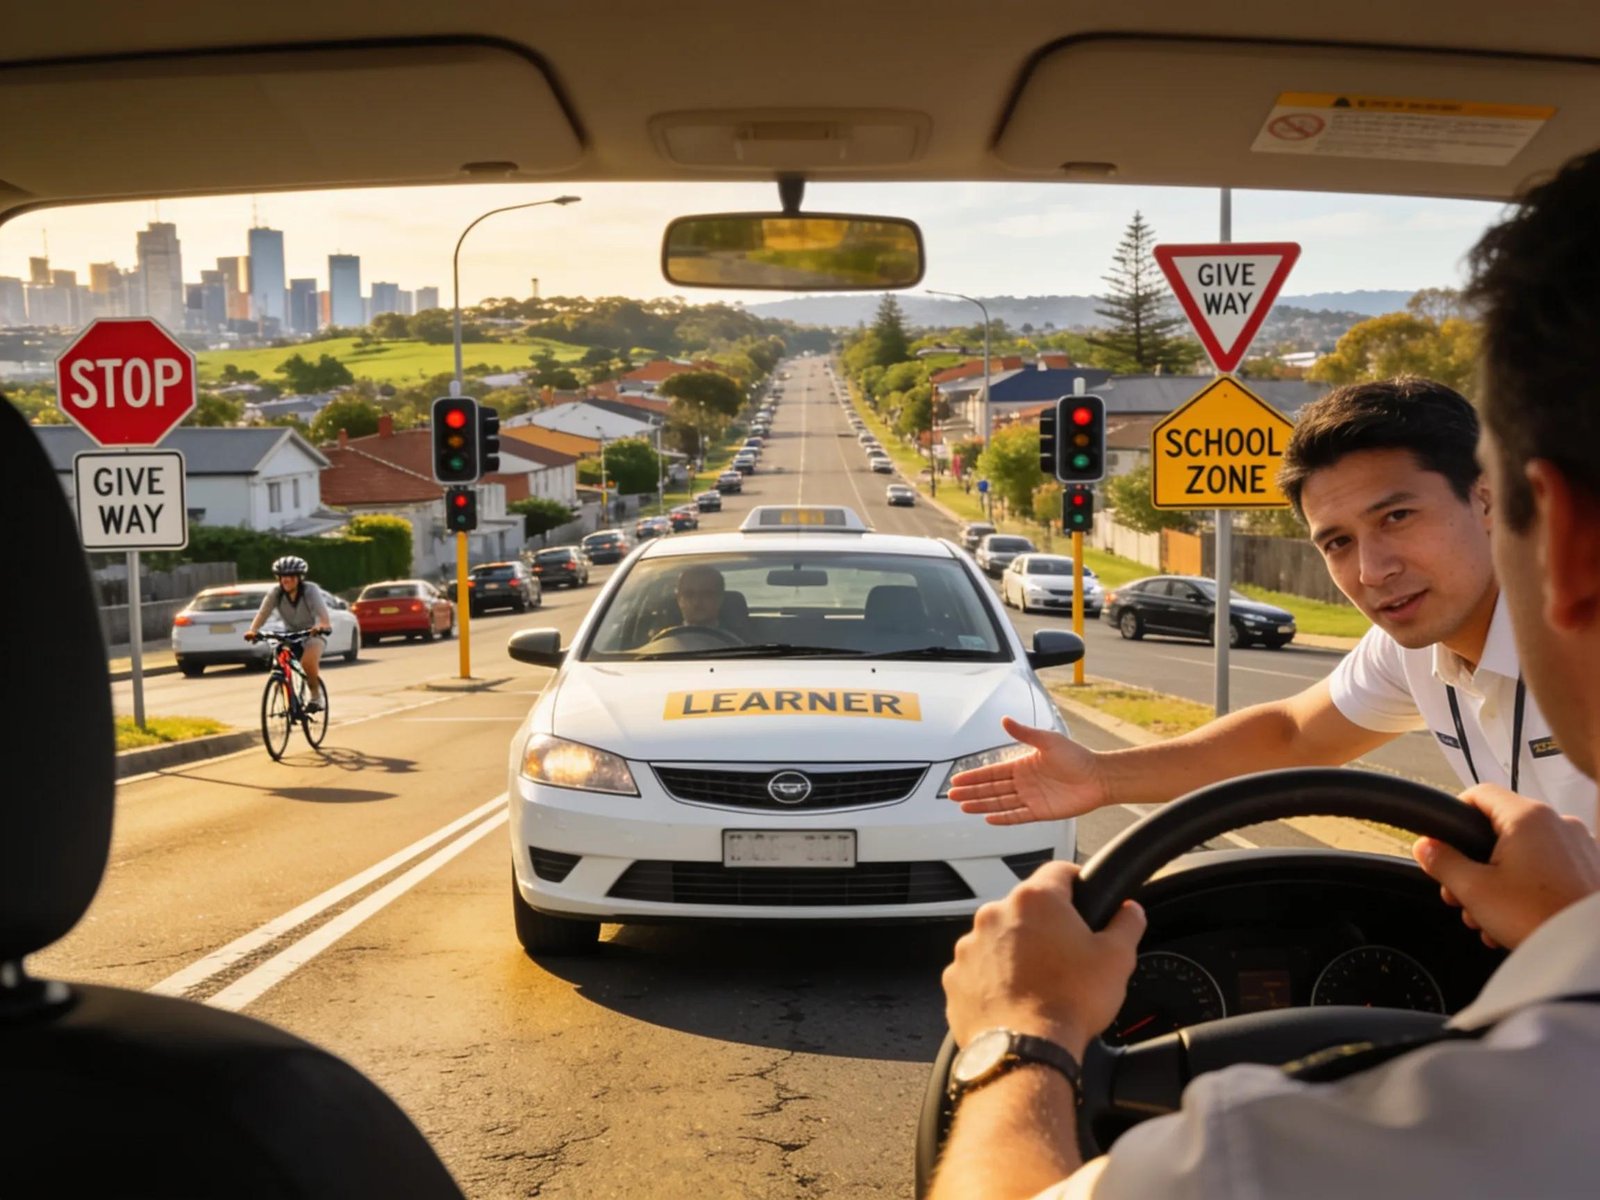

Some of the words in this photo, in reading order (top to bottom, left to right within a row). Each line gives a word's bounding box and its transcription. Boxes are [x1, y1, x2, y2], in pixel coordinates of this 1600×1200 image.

[1198, 263, 1256, 287] GIVE
[1203, 292, 1253, 315] WAY
[70, 356, 183, 409] STOP
[1165, 427, 1282, 458] SCHOOL
[93, 467, 165, 497] GIVE
[1185, 465, 1266, 494] ZONE
[98, 503, 165, 535] WAY
[682, 690, 903, 716] LEARNER
